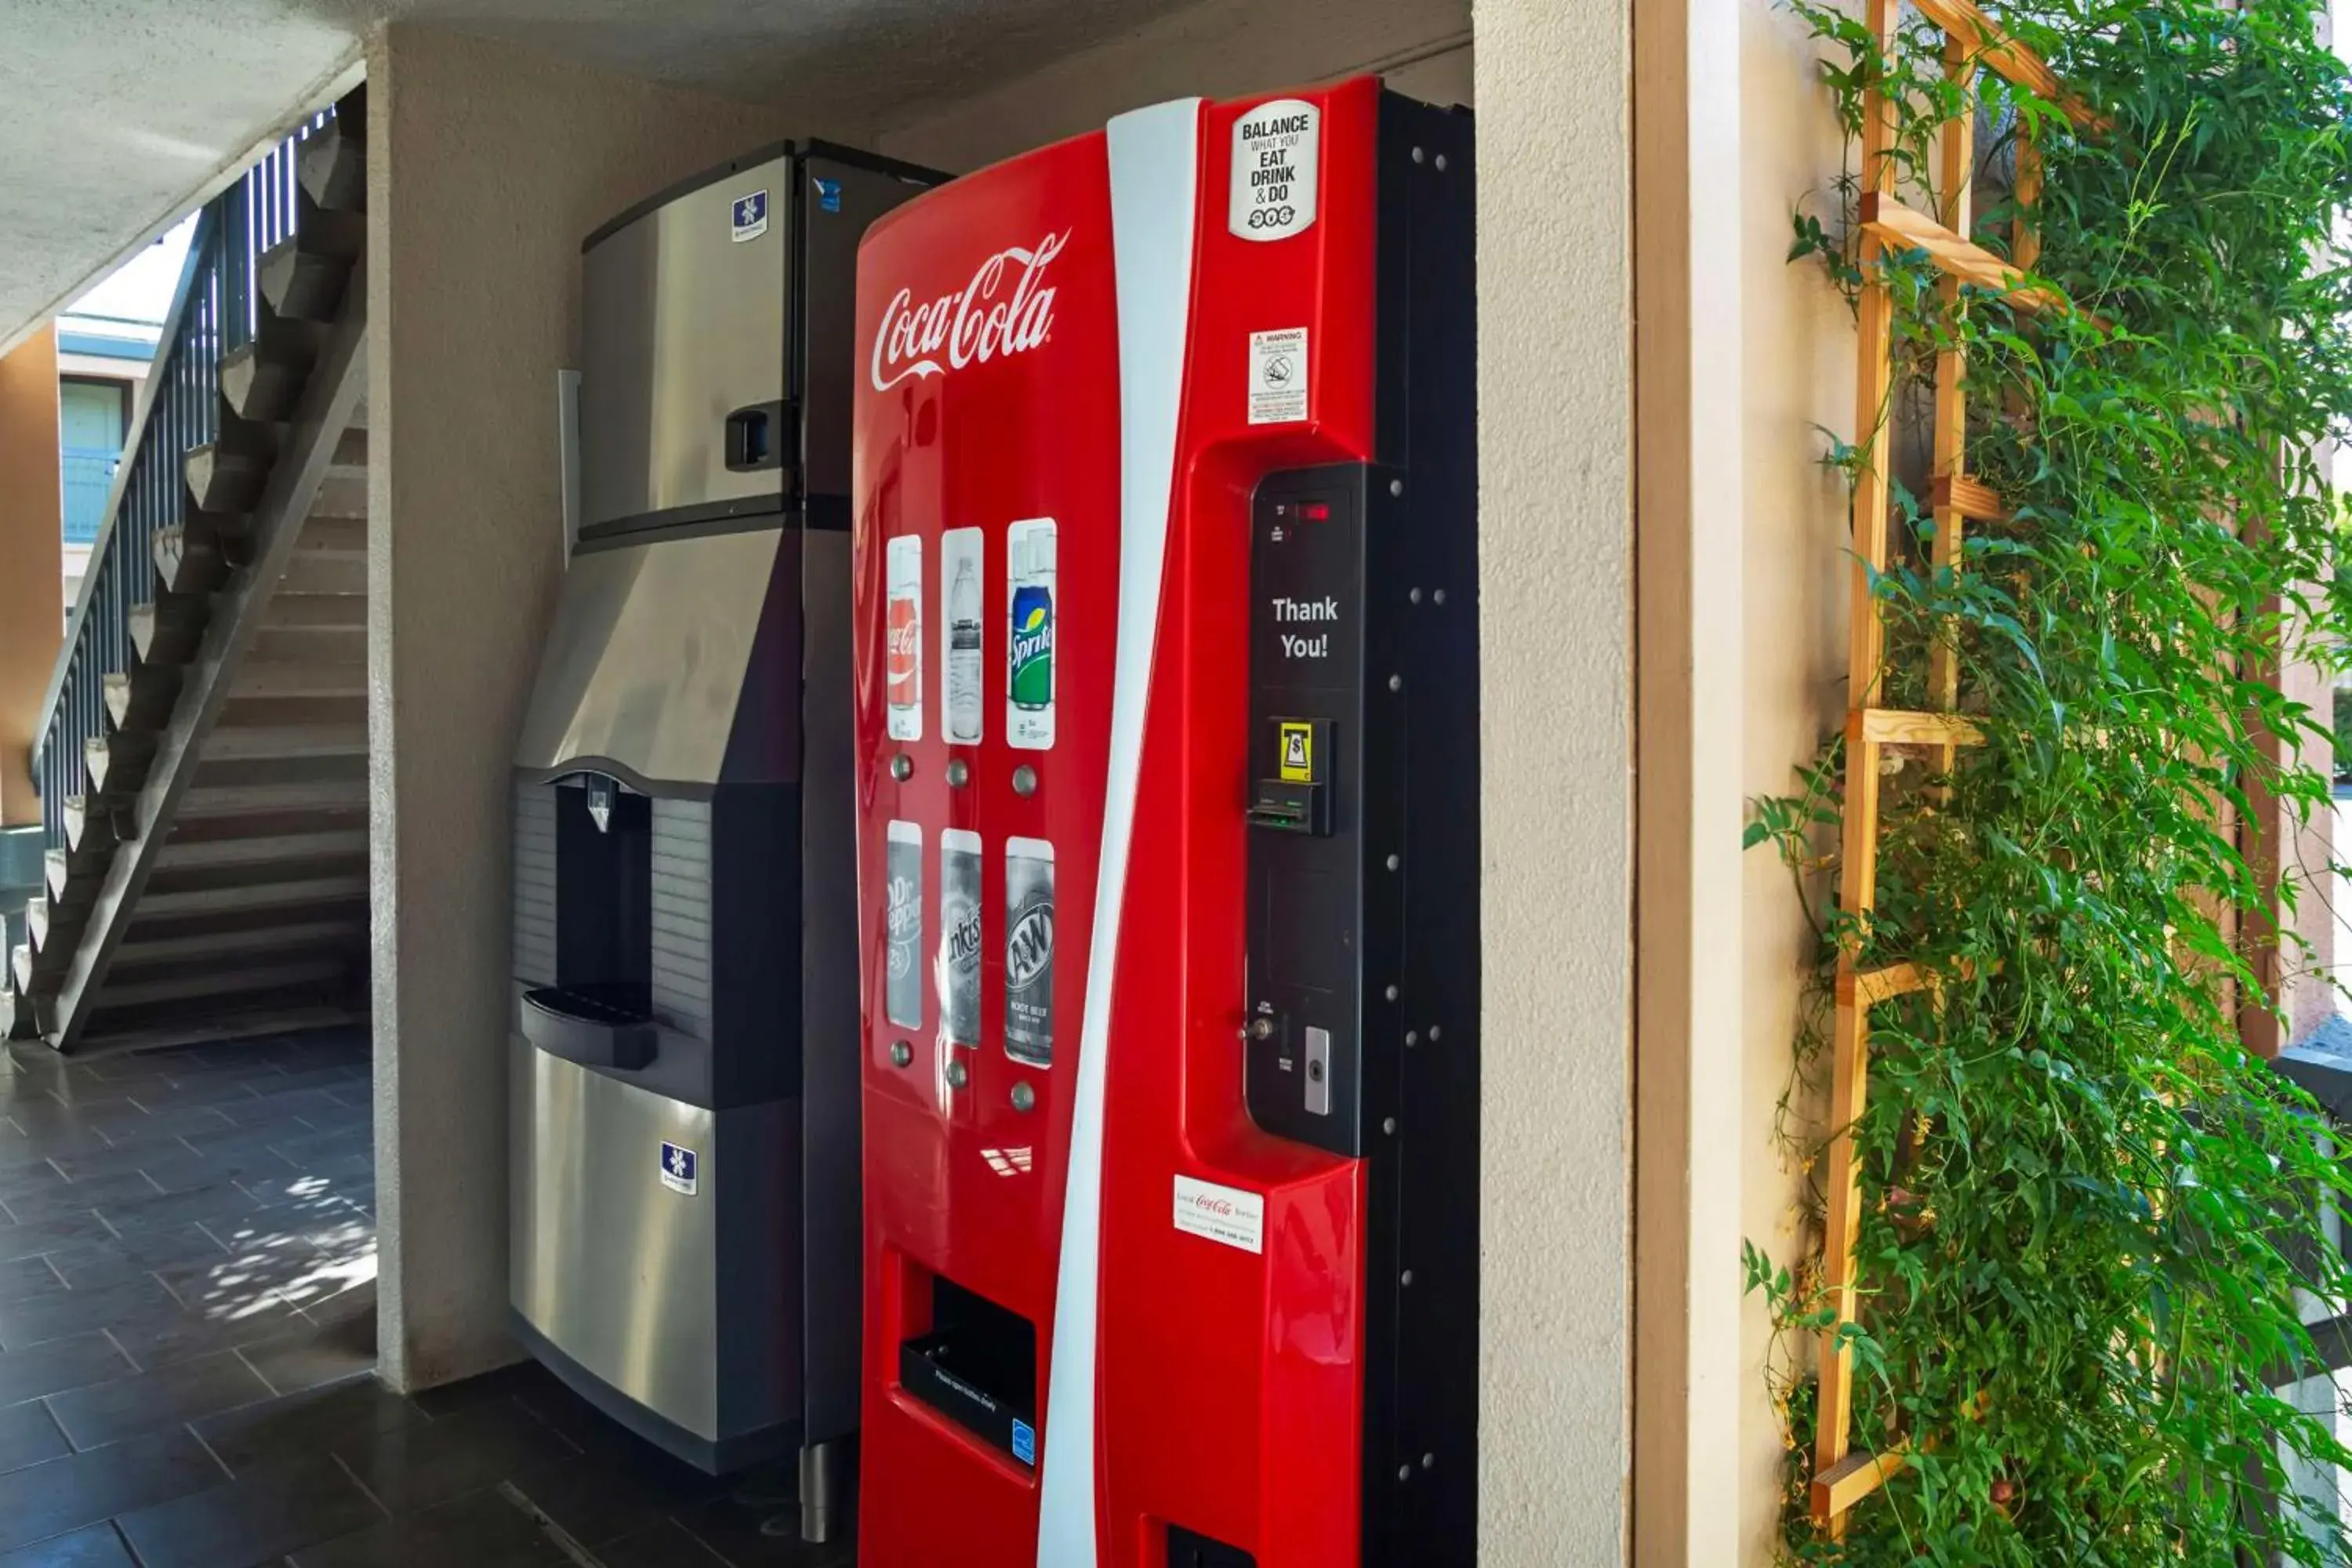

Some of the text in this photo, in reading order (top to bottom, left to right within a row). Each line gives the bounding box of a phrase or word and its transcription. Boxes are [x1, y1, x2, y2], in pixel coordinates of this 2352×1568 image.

[1243, 114, 1308, 140] BALANCE
[1251, 134, 1299, 151] WHAT YOU
[1260, 149, 1287, 167] EAT
[1251, 166, 1295, 187] DRINK
[1256, 184, 1288, 204] & DO
[871, 226, 1073, 391] Coca-Cola
[1266, 332, 1302, 342] WARNING
[1272, 596, 1338, 622] Thank
[1281, 633, 1328, 658] You!
[949, 913, 982, 963] nkis
[1011, 906, 1048, 986] A&W
